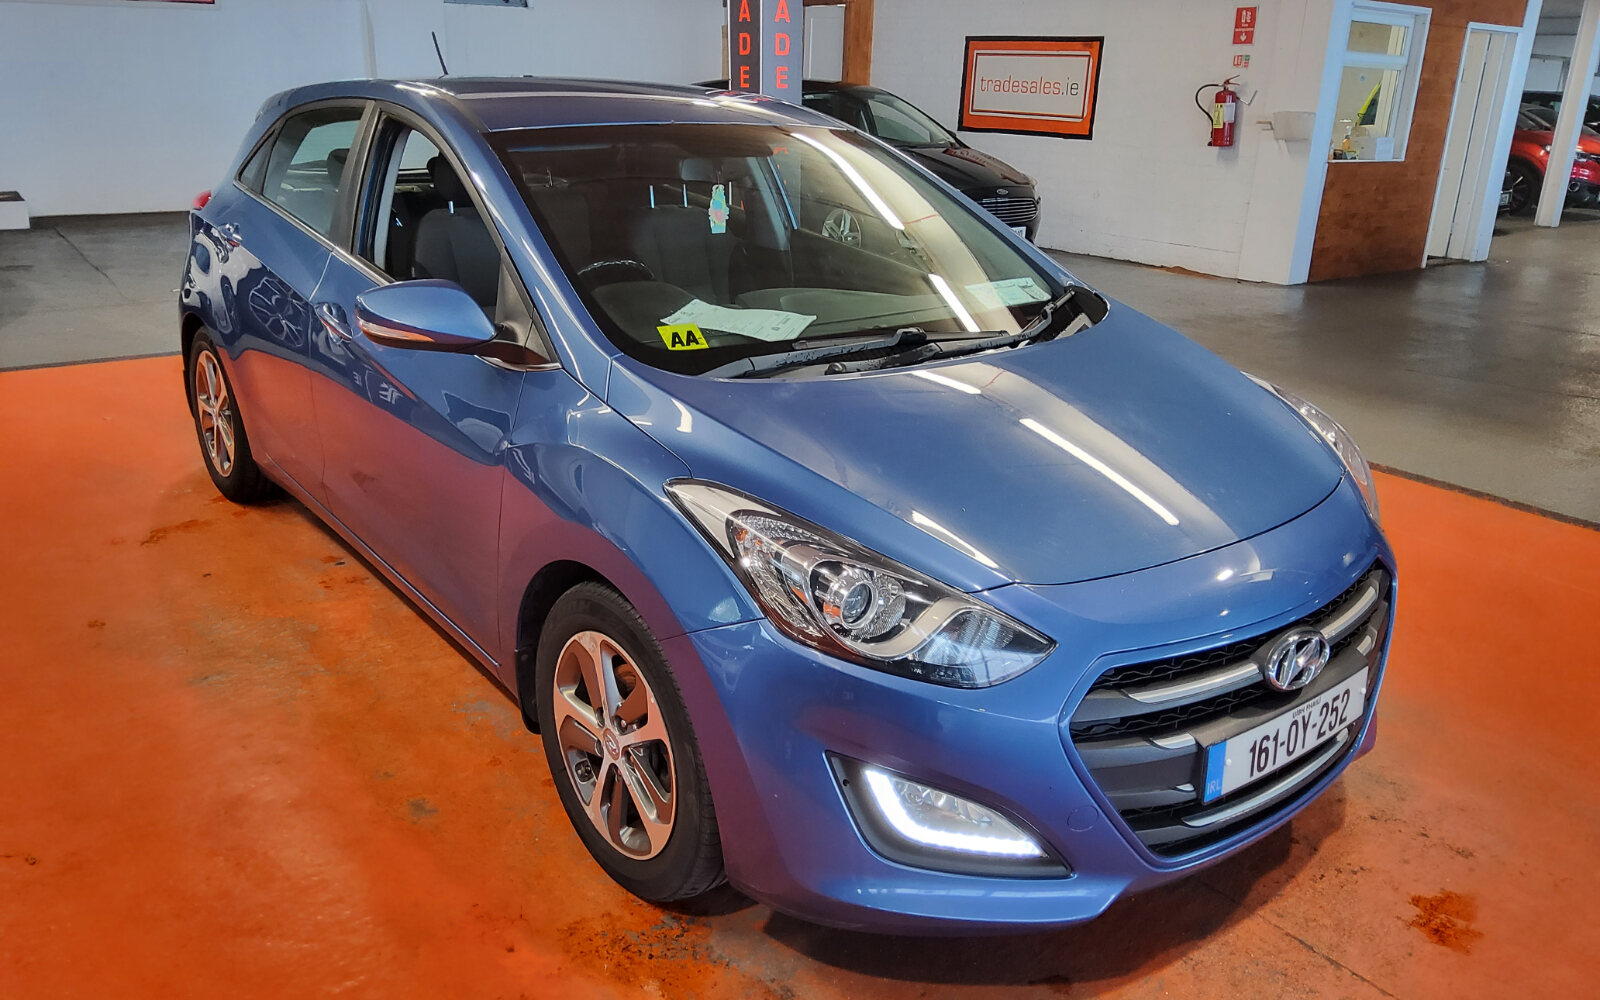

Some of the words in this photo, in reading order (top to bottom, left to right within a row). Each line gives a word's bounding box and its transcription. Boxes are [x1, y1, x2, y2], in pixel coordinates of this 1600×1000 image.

[980, 74, 1079, 96] tradesales.ie
[671, 330, 700, 348] AA
[1249, 688, 1350, 777] 161-OY-252
[1207, 778, 1222, 795] IRL
